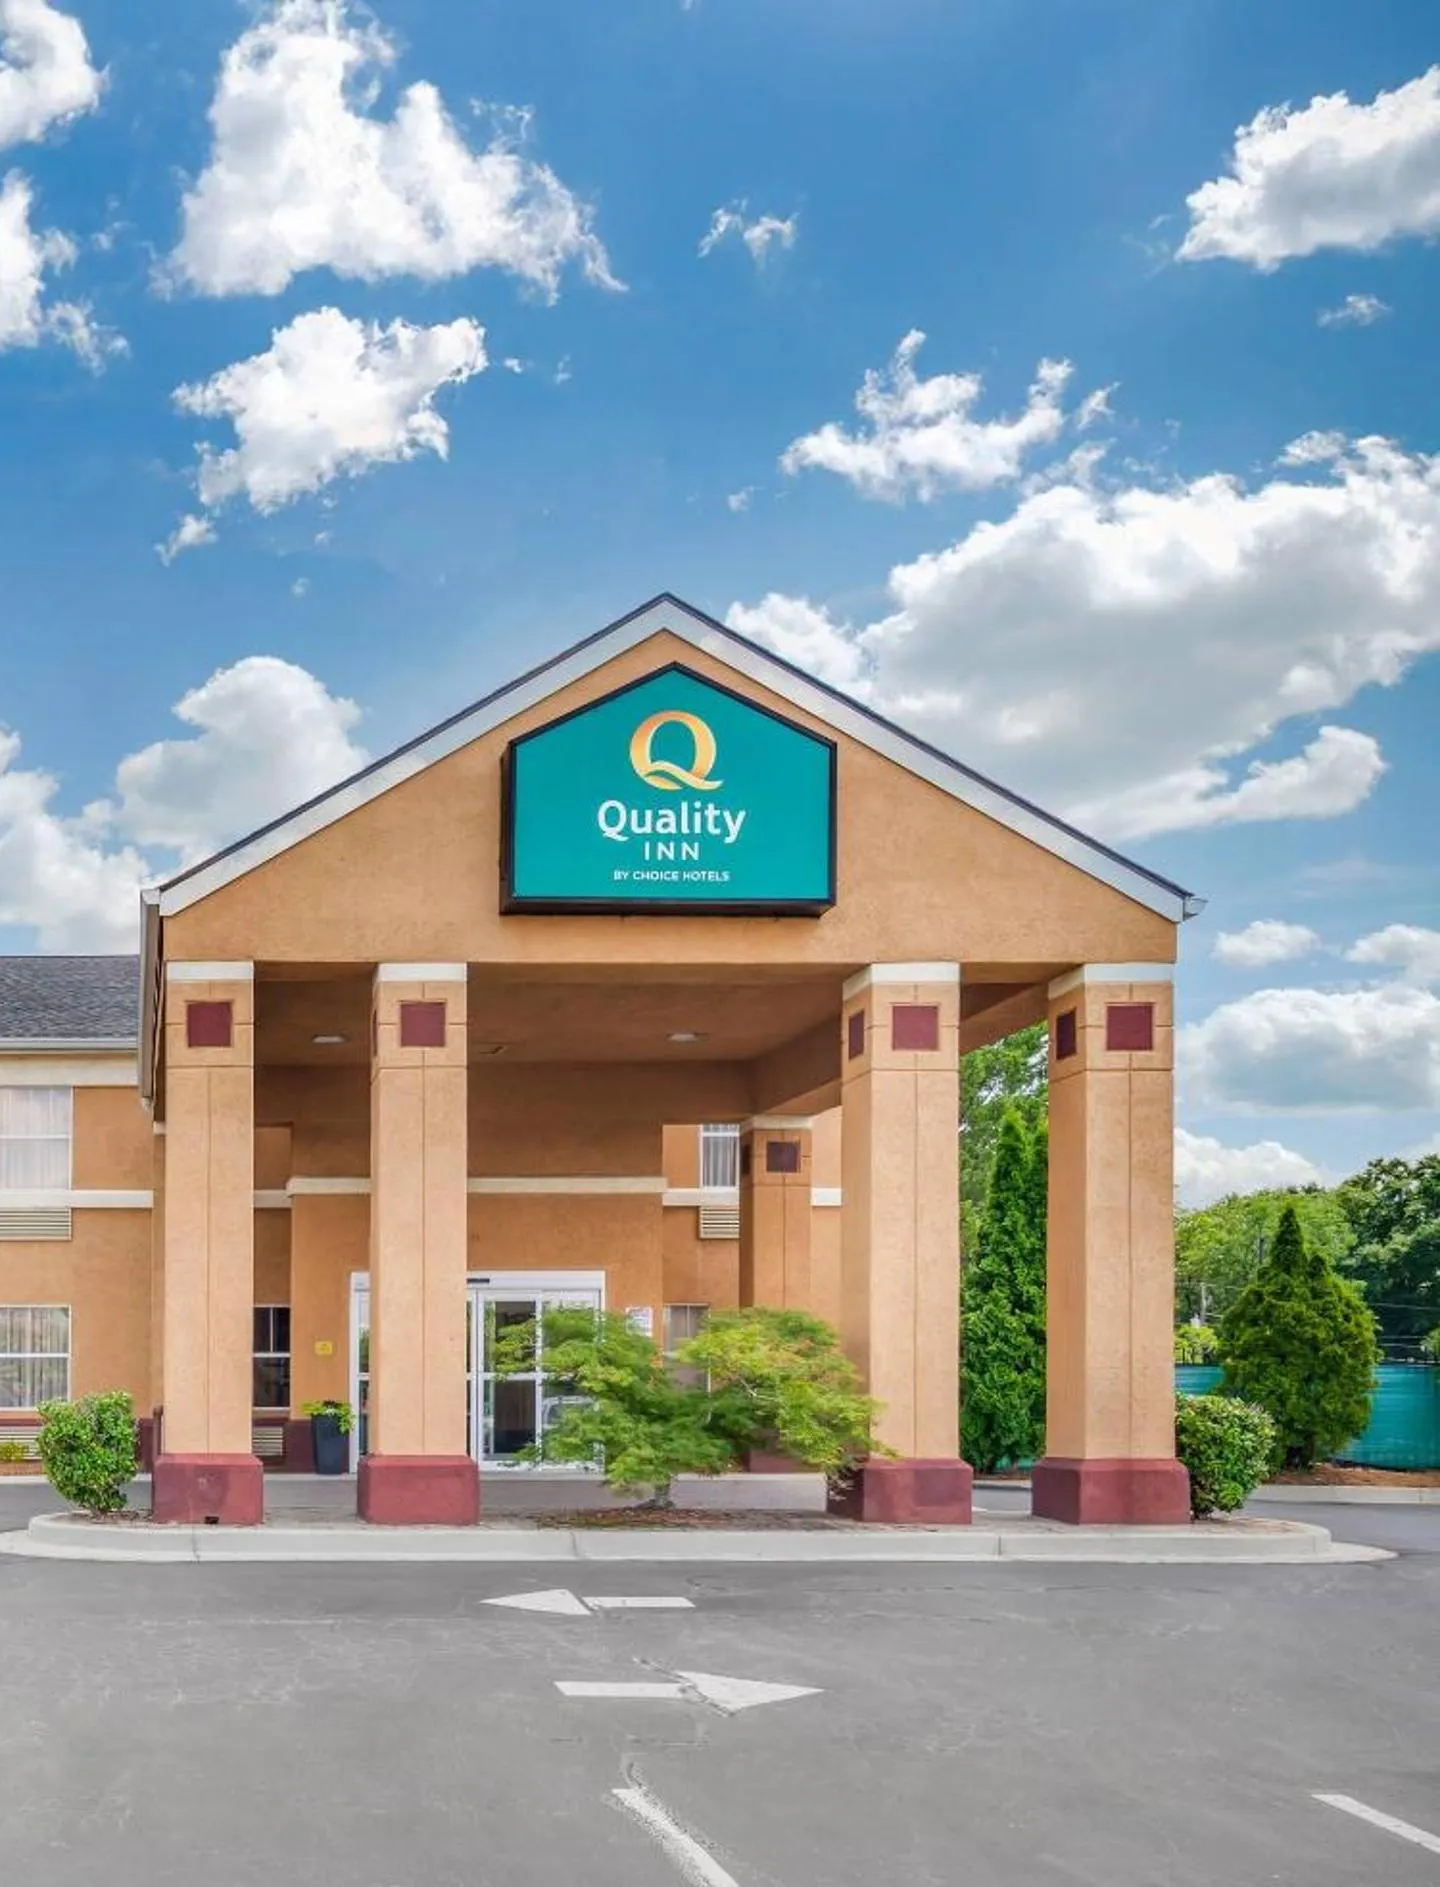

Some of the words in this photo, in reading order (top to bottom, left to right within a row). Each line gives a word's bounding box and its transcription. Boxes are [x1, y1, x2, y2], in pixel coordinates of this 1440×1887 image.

[629, 710, 723, 791] Q
[597, 799, 747, 844] Quality
[644, 841, 699, 861] INN
[613, 870, 629, 881] BY
[632, 870, 679, 881] CHOICE
[682, 870, 730, 882] HOTELS
